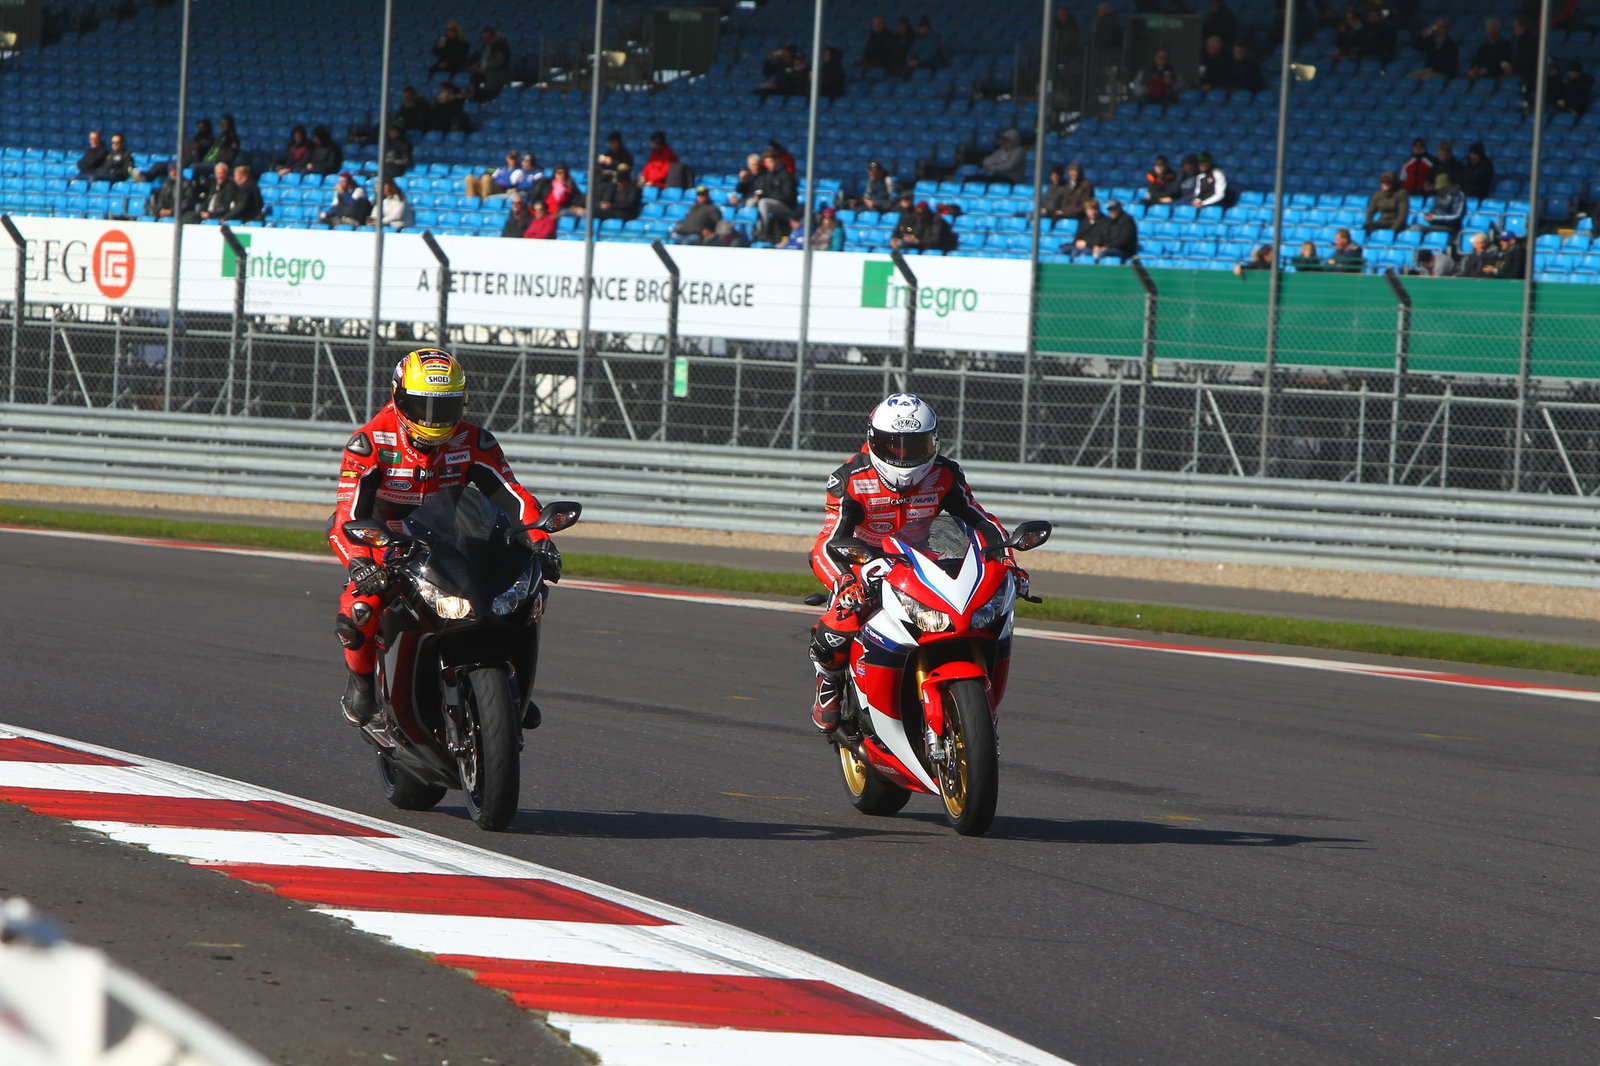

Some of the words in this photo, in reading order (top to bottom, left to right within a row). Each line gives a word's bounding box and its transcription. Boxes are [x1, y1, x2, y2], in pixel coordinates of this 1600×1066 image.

[24, 239, 88, 283] EFG
[416, 269, 430, 292] A
[437, 267, 508, 296] ETTER
[513, 273, 628, 301] INSURANCE
[635, 278, 755, 307] BROKERAGE
[886, 275, 978, 317] inegro
